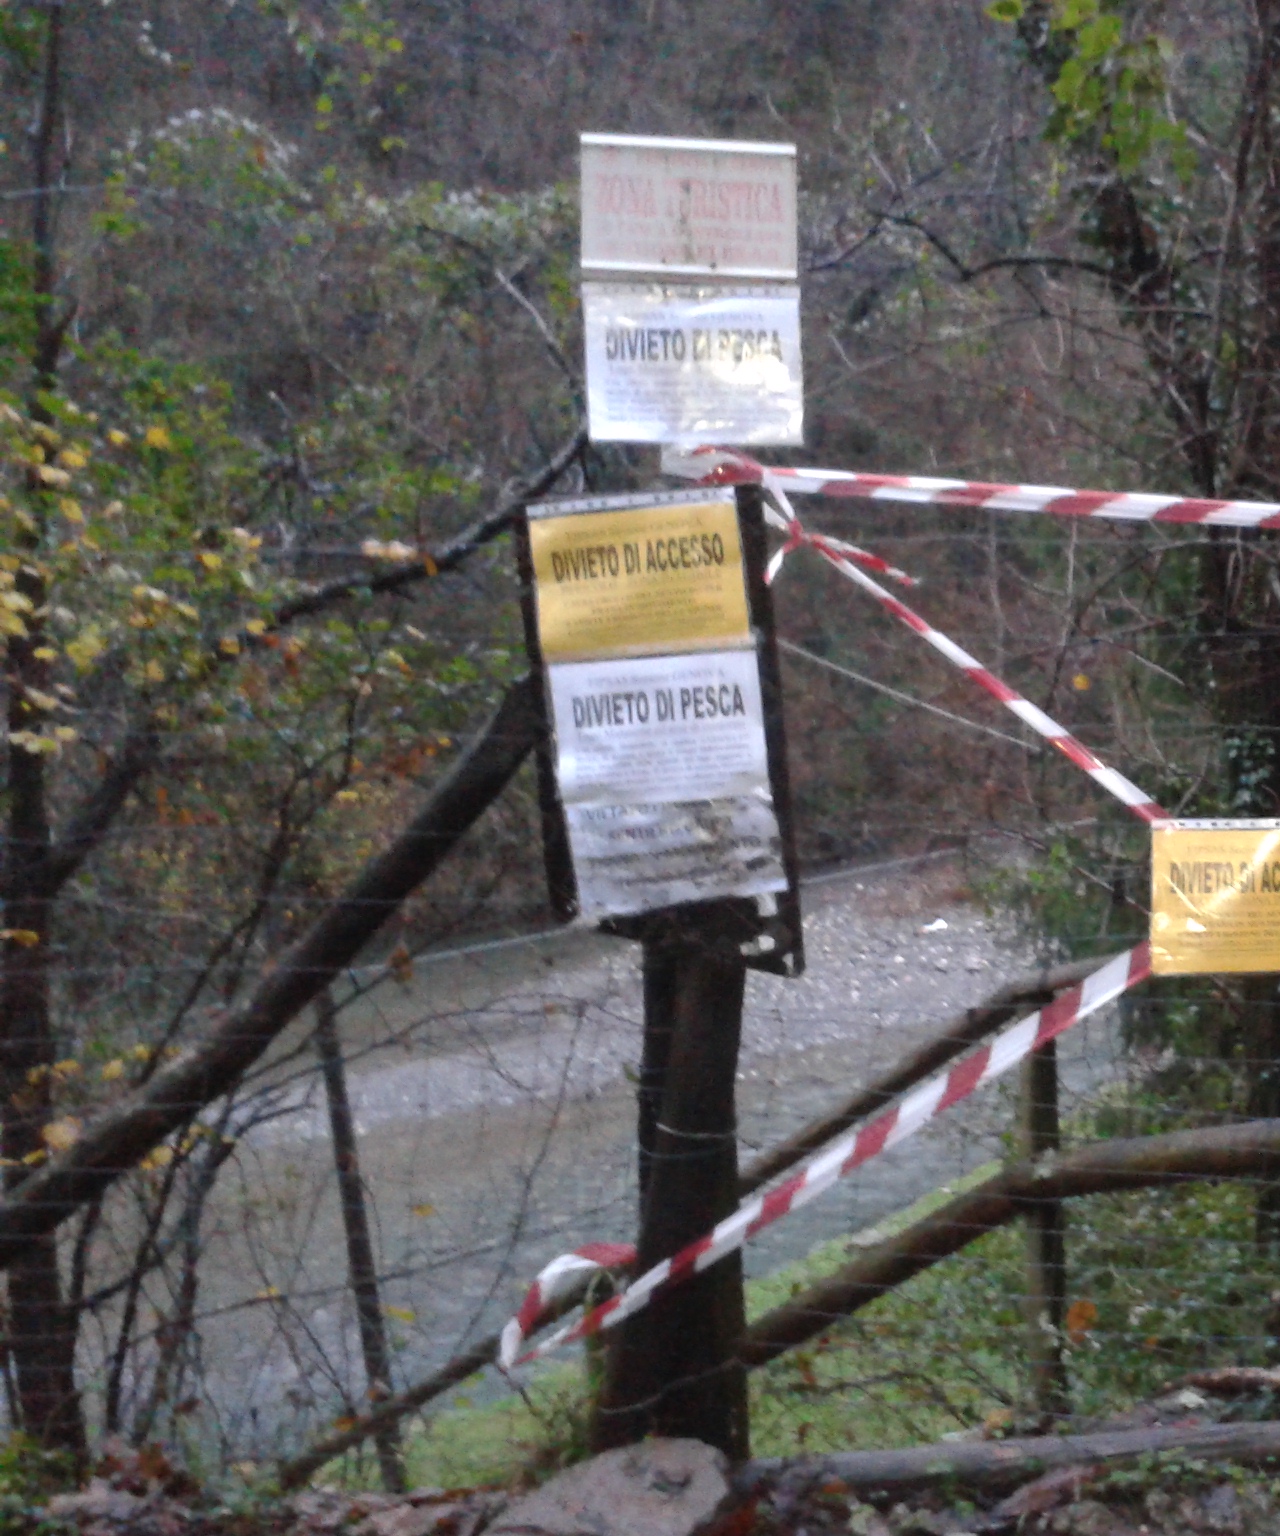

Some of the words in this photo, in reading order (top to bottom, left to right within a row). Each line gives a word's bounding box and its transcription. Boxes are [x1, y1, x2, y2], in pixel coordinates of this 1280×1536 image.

[606, 327, 686, 362] DIVIETO
[691, 328, 712, 362] DI
[551, 543, 619, 583] DIVIETO
[622, 542, 642, 575] DI
[646, 532, 726, 573] ACCESSO
[572, 689, 649, 728] DIVIETO
[655, 687, 676, 722] DI
[680, 682, 747, 720] PESCA
[1170, 860, 1235, 894] DIVIETO
